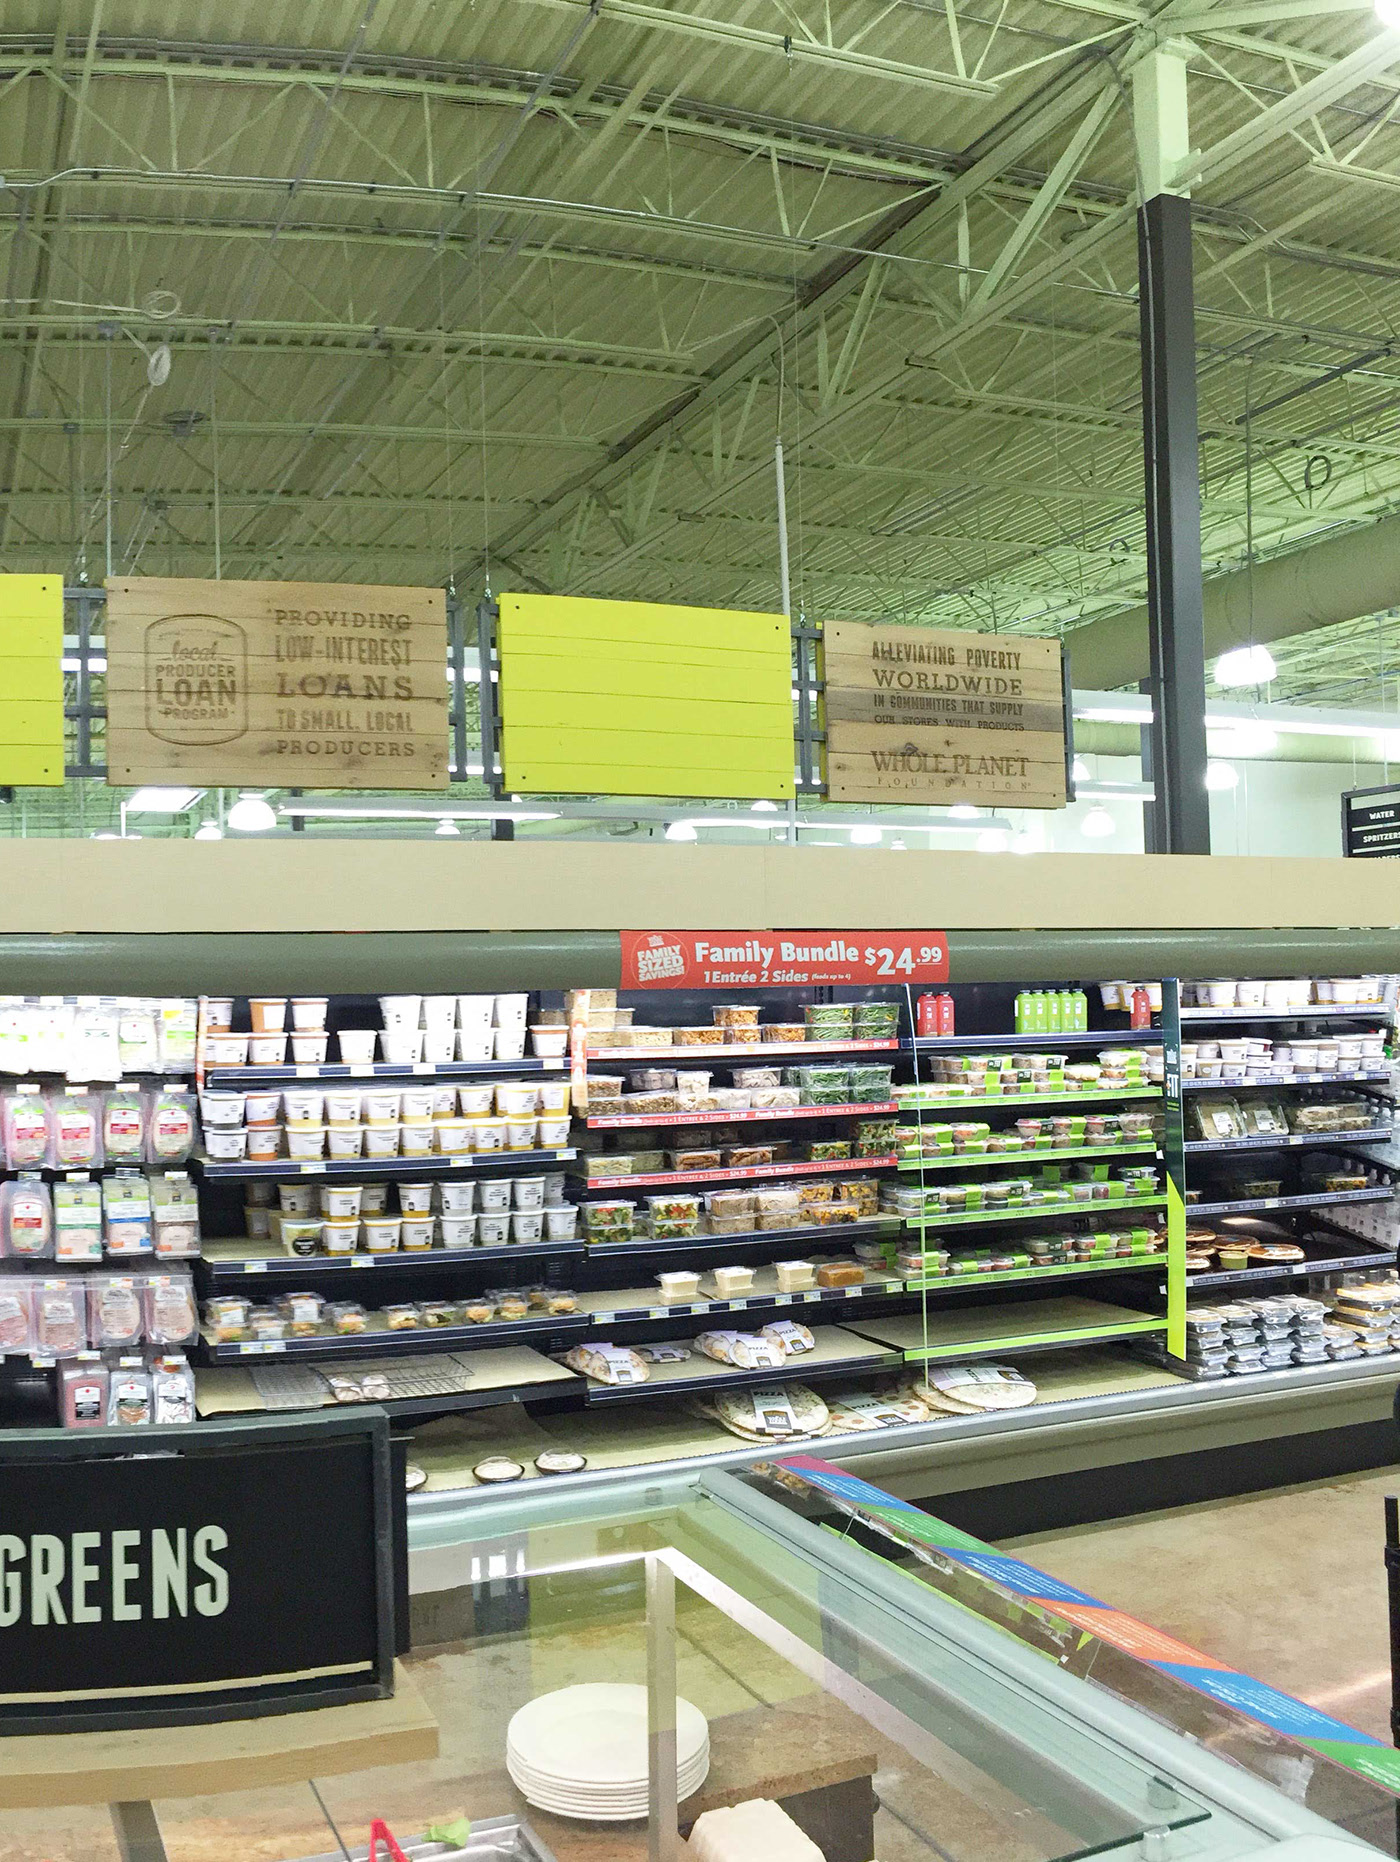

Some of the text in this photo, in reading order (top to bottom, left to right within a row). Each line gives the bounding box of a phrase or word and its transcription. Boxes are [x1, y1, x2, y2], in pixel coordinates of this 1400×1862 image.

[275, 610, 411, 630] PROVIDING
[172, 641, 217, 661] local
[872, 641, 1021, 671] ALLEVIATING POVERTY
[156, 664, 236, 677] PRODUCER
[276, 673, 414, 701] LOANS
[872, 669, 1022, 696] WORLDWIDE
[156, 678, 236, 706] LOAN
[164, 708, 229, 720] PROGRAM
[874, 694, 1024, 716] IN COMMUNITIES THAT SUPPLY
[874, 715, 1025, 731] OUR STORES WITH PRODUCTS
[276, 739, 415, 757] PRODUCERS
[871, 750, 1029, 777] WHOLE PLANET
[1369, 810, 1396, 820] WATER
[1363, 832, 1400, 843] SPRITZERS
[637, 945, 681, 961] FAMILY
[695, 940, 774, 969] Family
[780, 940, 859, 962] Bundle
[864, 946, 942, 975] $24.99
[638, 955, 684, 973] SIZED
[638, 966, 685, 982] SAVINGS!
[712, 969, 757, 983] Entrée
[760, 970, 769, 982] 2
[772, 969, 809, 982] Sides
